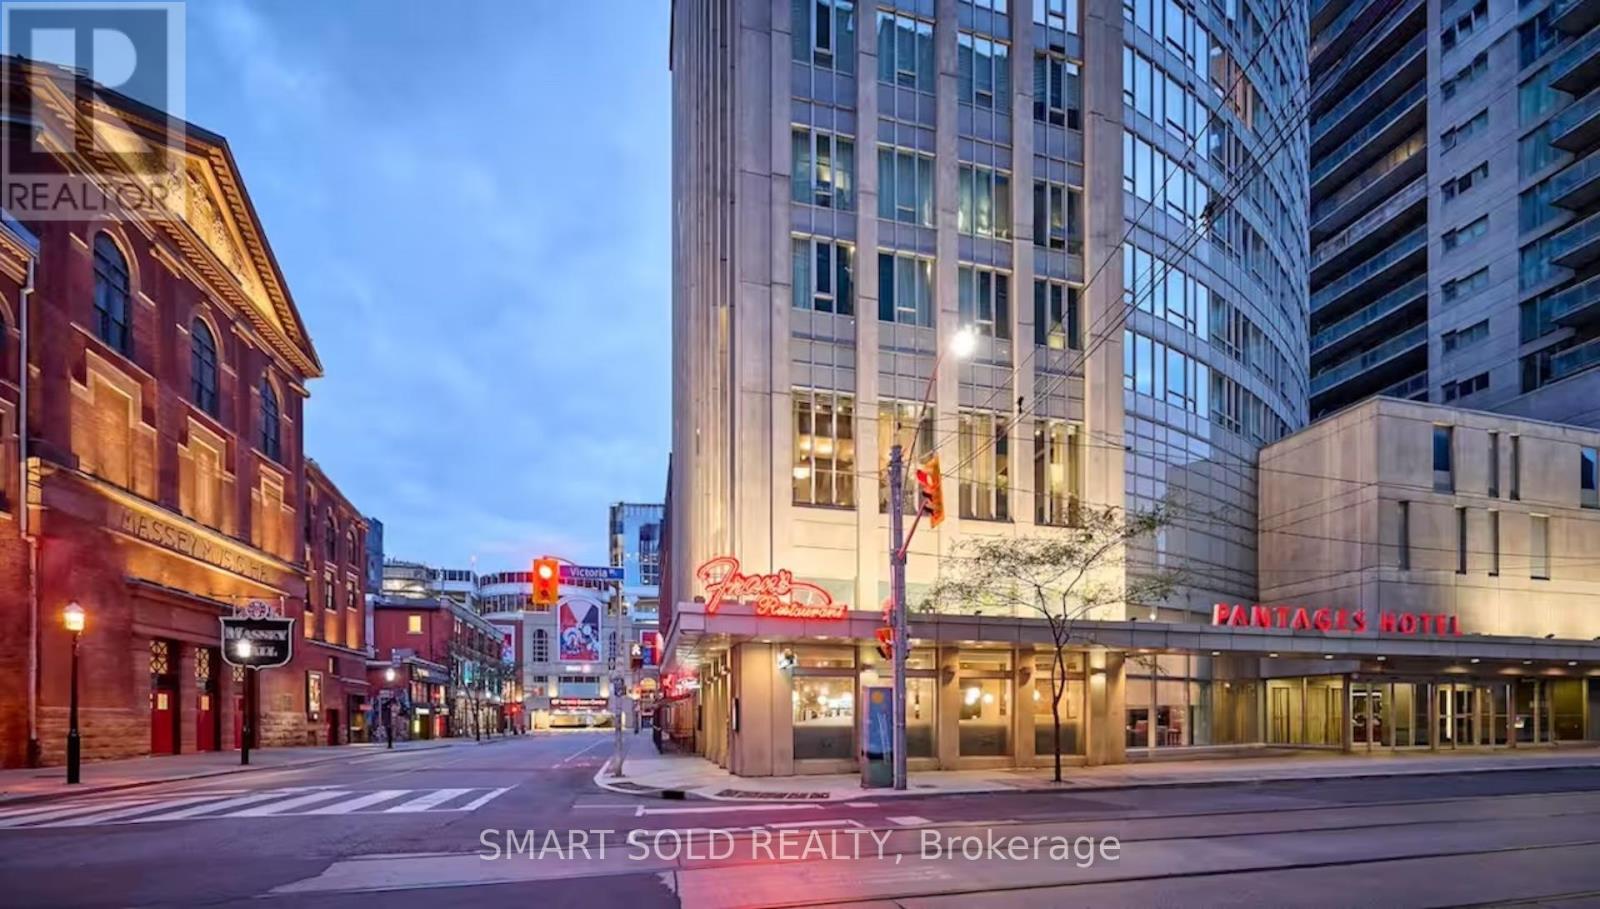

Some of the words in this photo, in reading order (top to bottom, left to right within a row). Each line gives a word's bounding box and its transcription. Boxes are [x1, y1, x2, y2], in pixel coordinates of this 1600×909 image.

[570, 567, 608, 578] Victoria
[756, 593, 848, 618] Restaurant
[1212, 603, 1367, 633] PANTAGES
[1379, 609, 1463, 637] HOTEL
[225, 626, 288, 641] MASSEY
